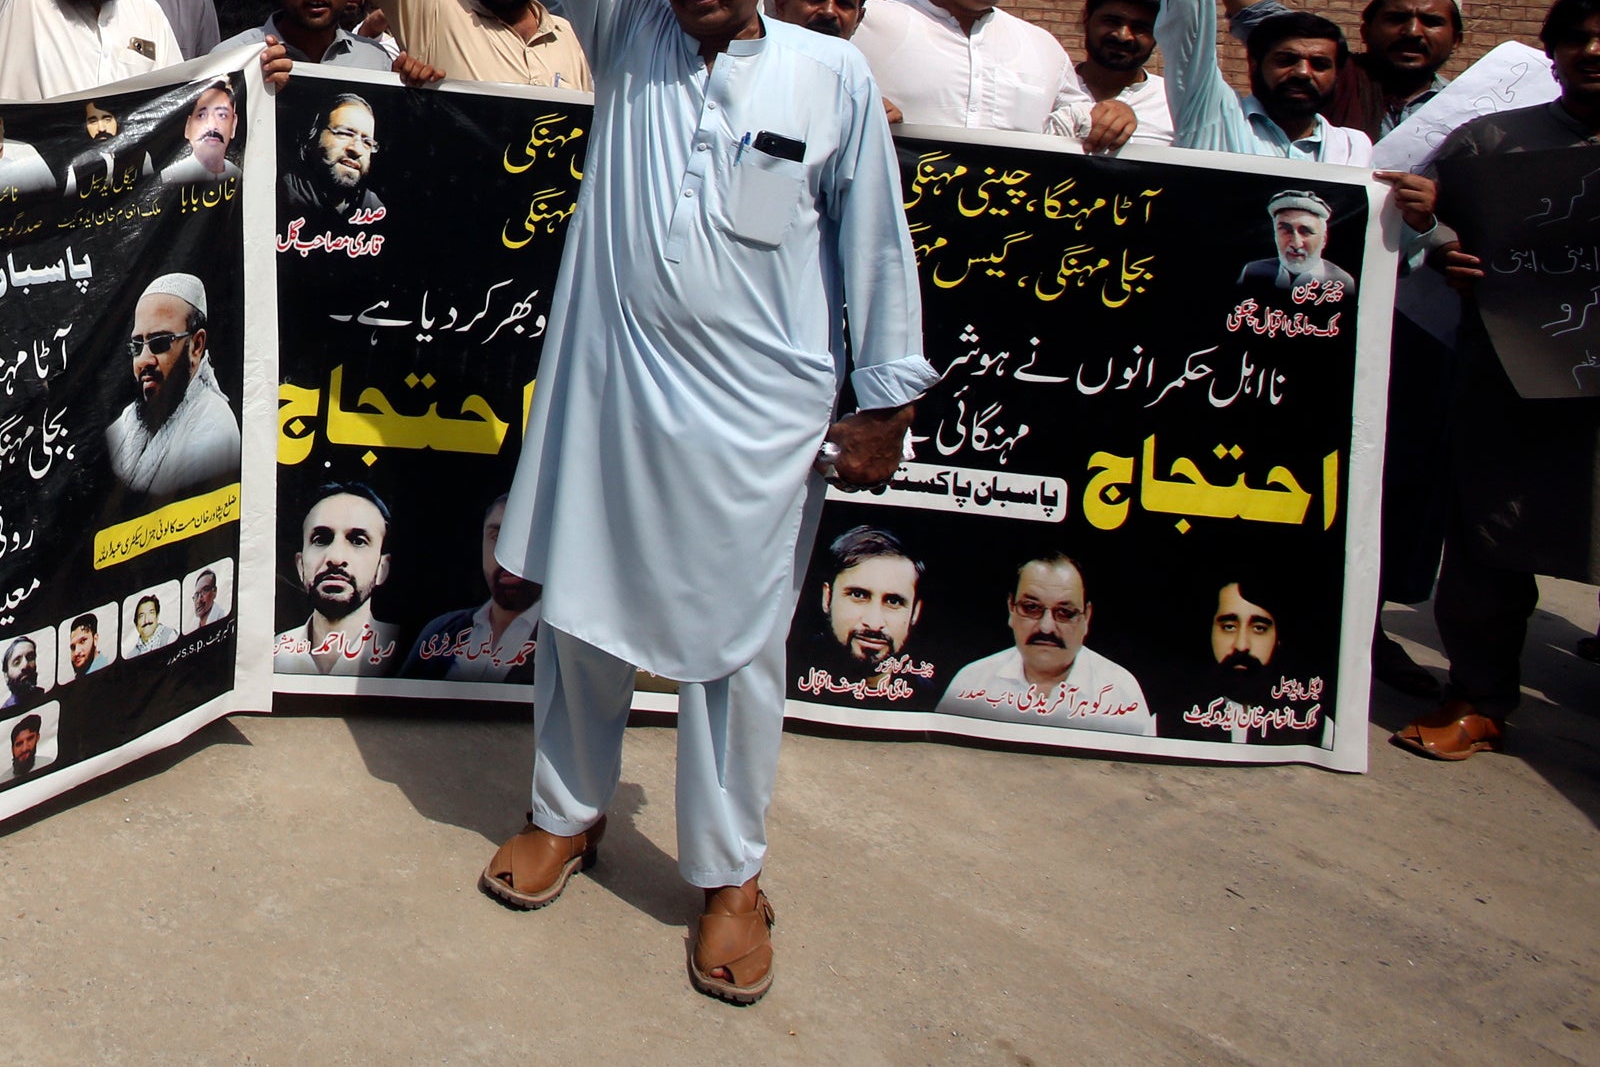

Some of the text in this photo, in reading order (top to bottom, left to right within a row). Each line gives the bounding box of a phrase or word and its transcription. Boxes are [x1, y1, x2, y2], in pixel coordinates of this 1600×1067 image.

[503, 112, 584, 174] مہنگی
[202, 177, 236, 208] خان
[903, 151, 968, 210] مہنگی
[958, 167, 1032, 217] چینی
[1114, 188, 1163, 226] آٹا
[348, 207, 386, 224] صدر
[347, 232, 385, 258] قاری
[933, 231, 1034, 289] گیس
[1102, 248, 1155, 308] بجلی
[415, 279, 513, 343] کر دیا
[34, 323, 73, 379] آٹا
[1014, 336, 1219, 409] حکمرانوں نے
[936, 385, 1030, 465] مہنگائی
[974, 475, 1059, 517] پاسبان
[1083, 433, 1338, 534] احتجاج
[312, 632, 344, 656] احمد
